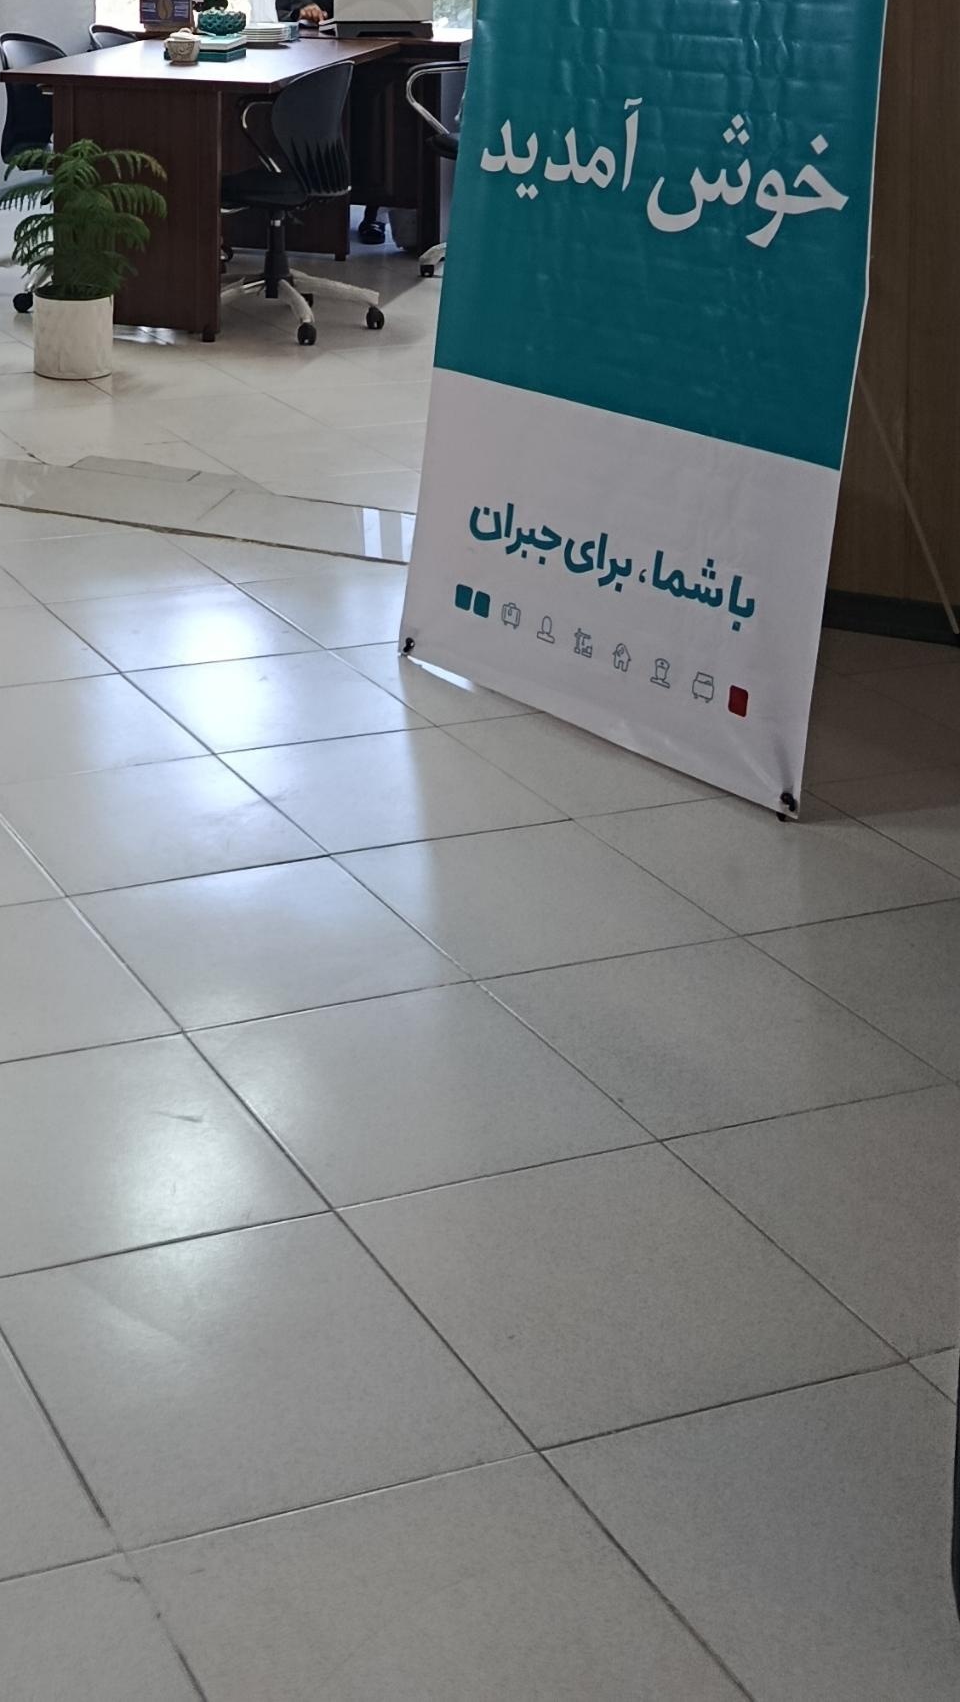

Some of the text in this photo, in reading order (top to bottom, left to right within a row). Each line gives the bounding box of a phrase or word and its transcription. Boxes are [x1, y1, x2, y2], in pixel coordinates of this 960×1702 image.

[480, 97, 850, 249] خوش آمدید
[469, 502, 562, 565] جبران
[563, 532, 633, 593] برای
